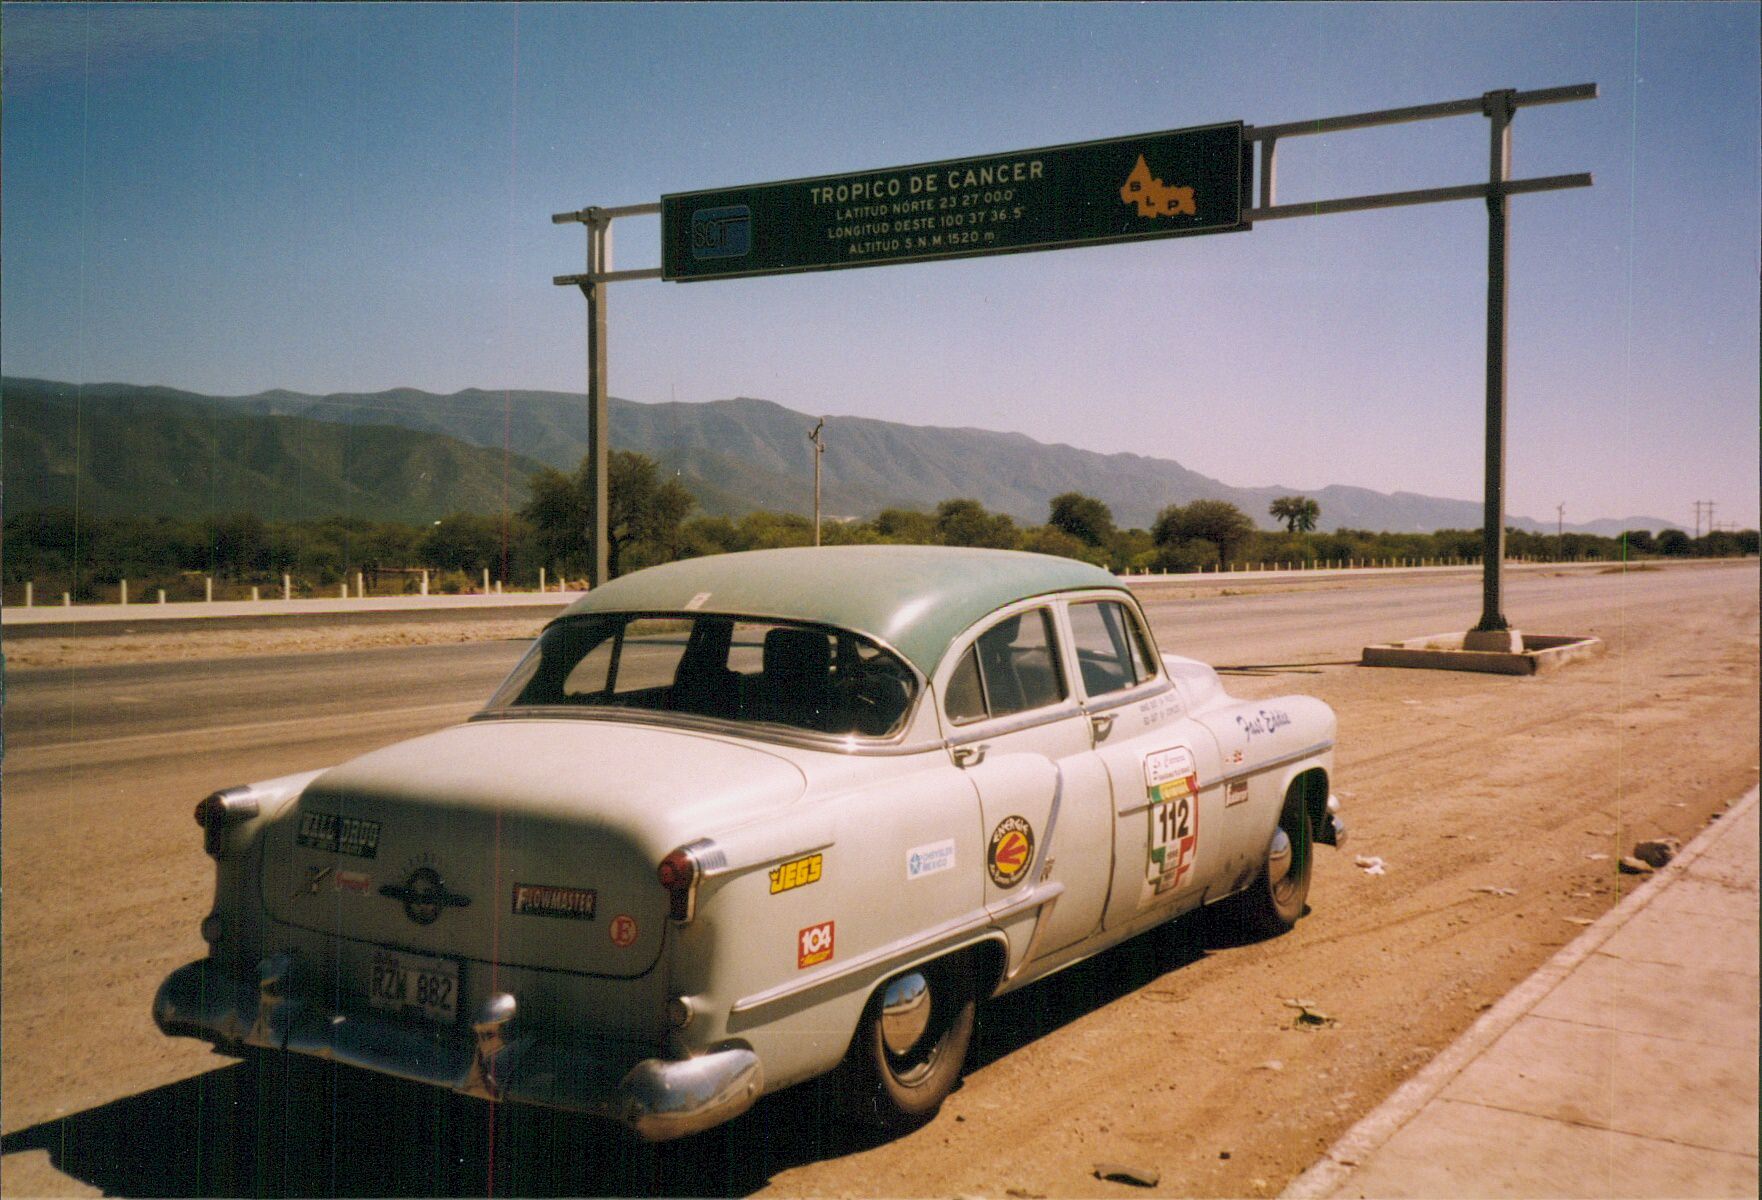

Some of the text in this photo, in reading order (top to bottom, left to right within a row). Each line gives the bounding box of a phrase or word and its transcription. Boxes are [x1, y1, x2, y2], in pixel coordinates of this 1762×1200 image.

[810, 160, 1044, 205] TROPICO DE CANCER
[836, 203, 889, 221] LATITUD
[939, 196, 957, 210] 23
[827, 222, 890, 240] LONGITUD
[894, 217, 936, 232] OESTE
[940, 213, 964, 228] 100
[848, 238, 900, 255] ALTITUD
[948, 230, 979, 245] 1520
[1159, 798, 1189, 844] 112
[802, 925, 832, 955] 104
